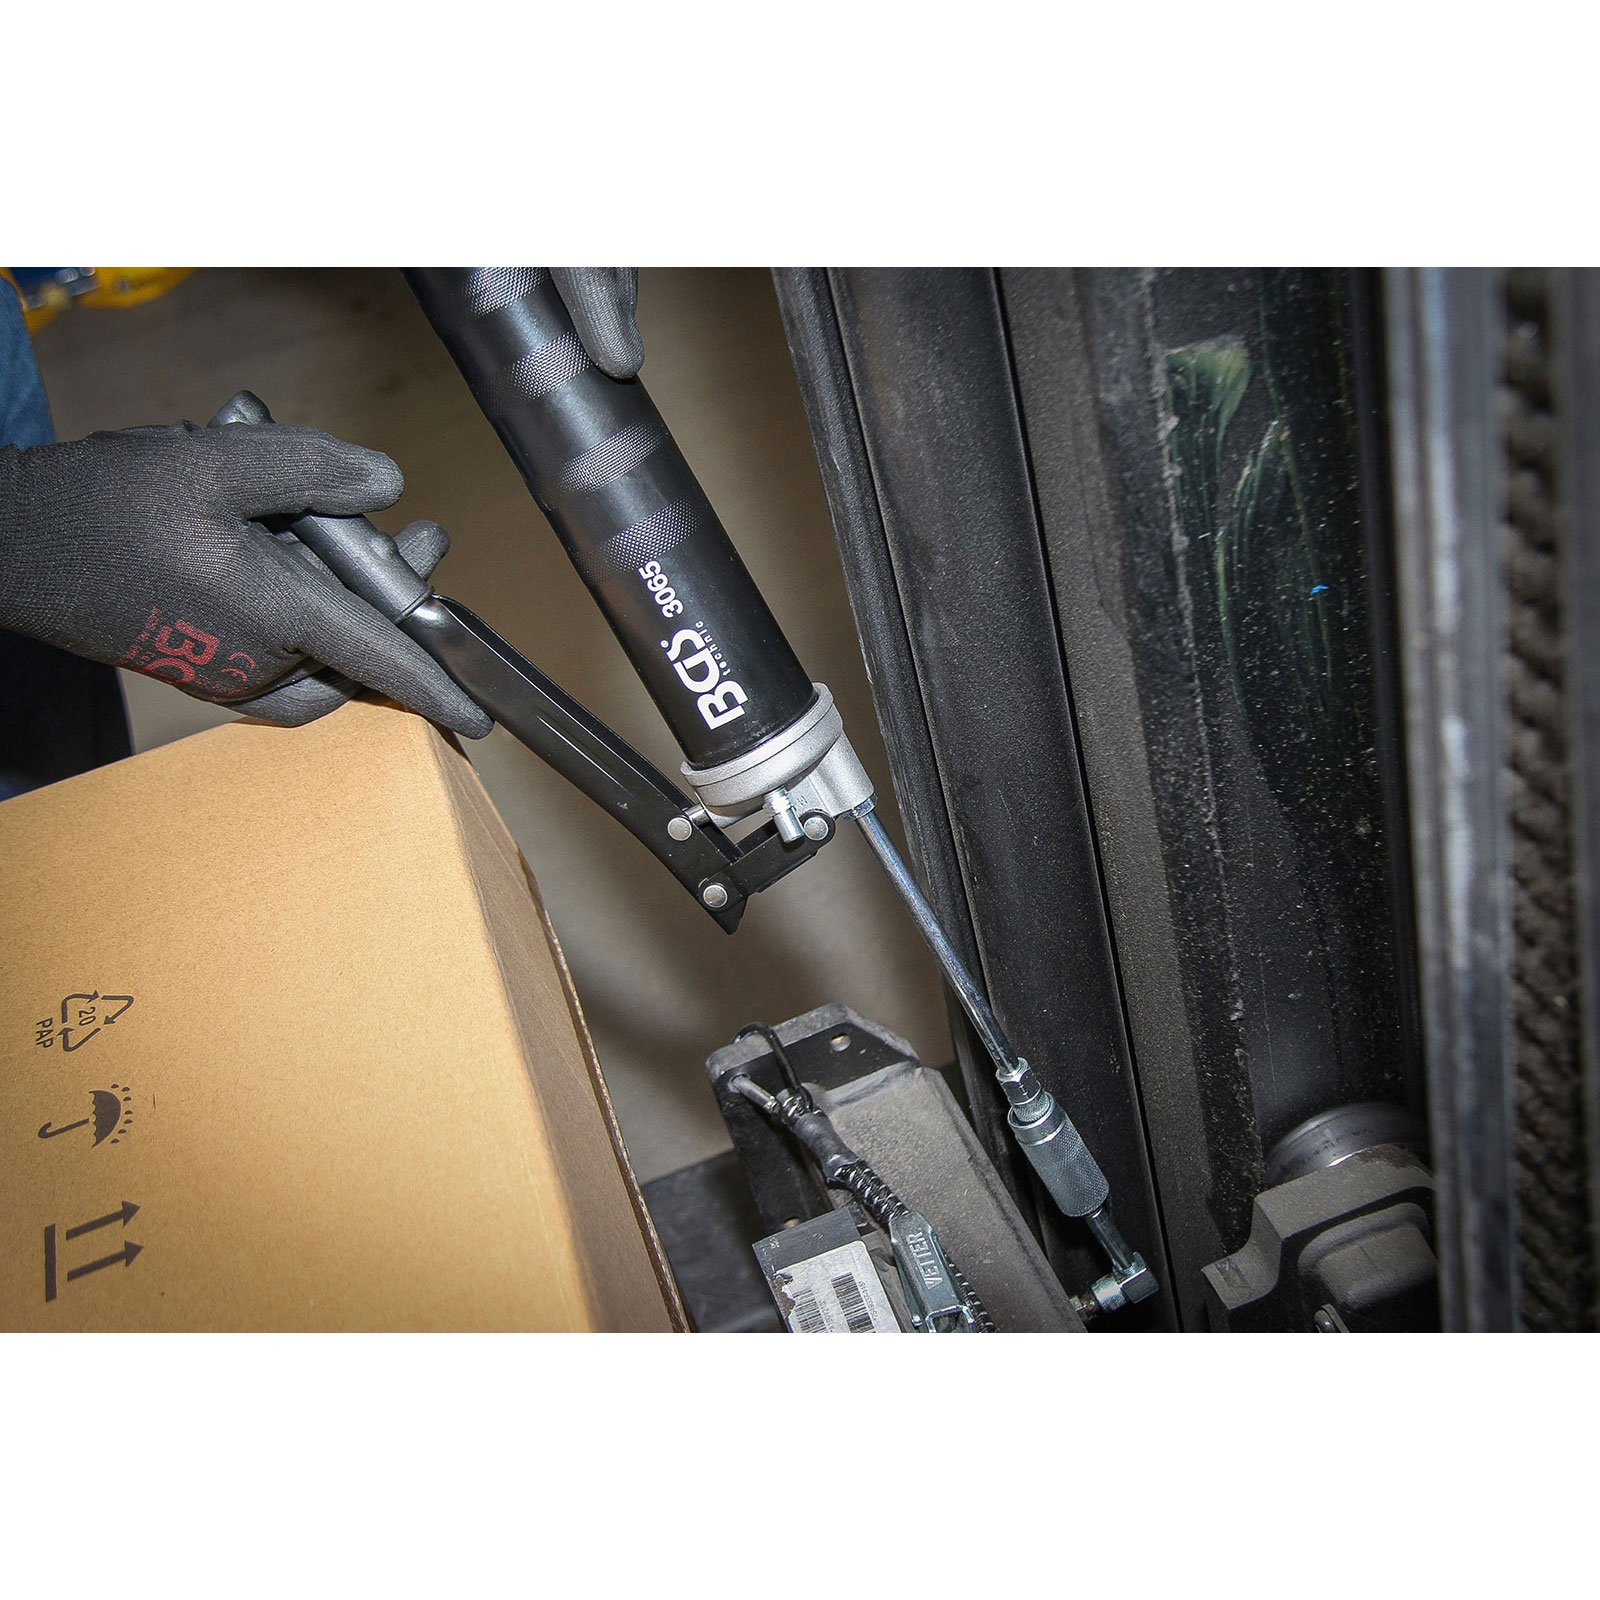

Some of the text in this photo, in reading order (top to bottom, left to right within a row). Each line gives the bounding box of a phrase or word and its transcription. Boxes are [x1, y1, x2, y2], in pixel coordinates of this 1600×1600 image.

[638, 560, 684, 618] 3065
[666, 628, 749, 731] BGS
[35, 1017, 54, 1049] PAP
[78, 1006, 97, 1027] 20
[907, 1231, 943, 1290] VETTER
